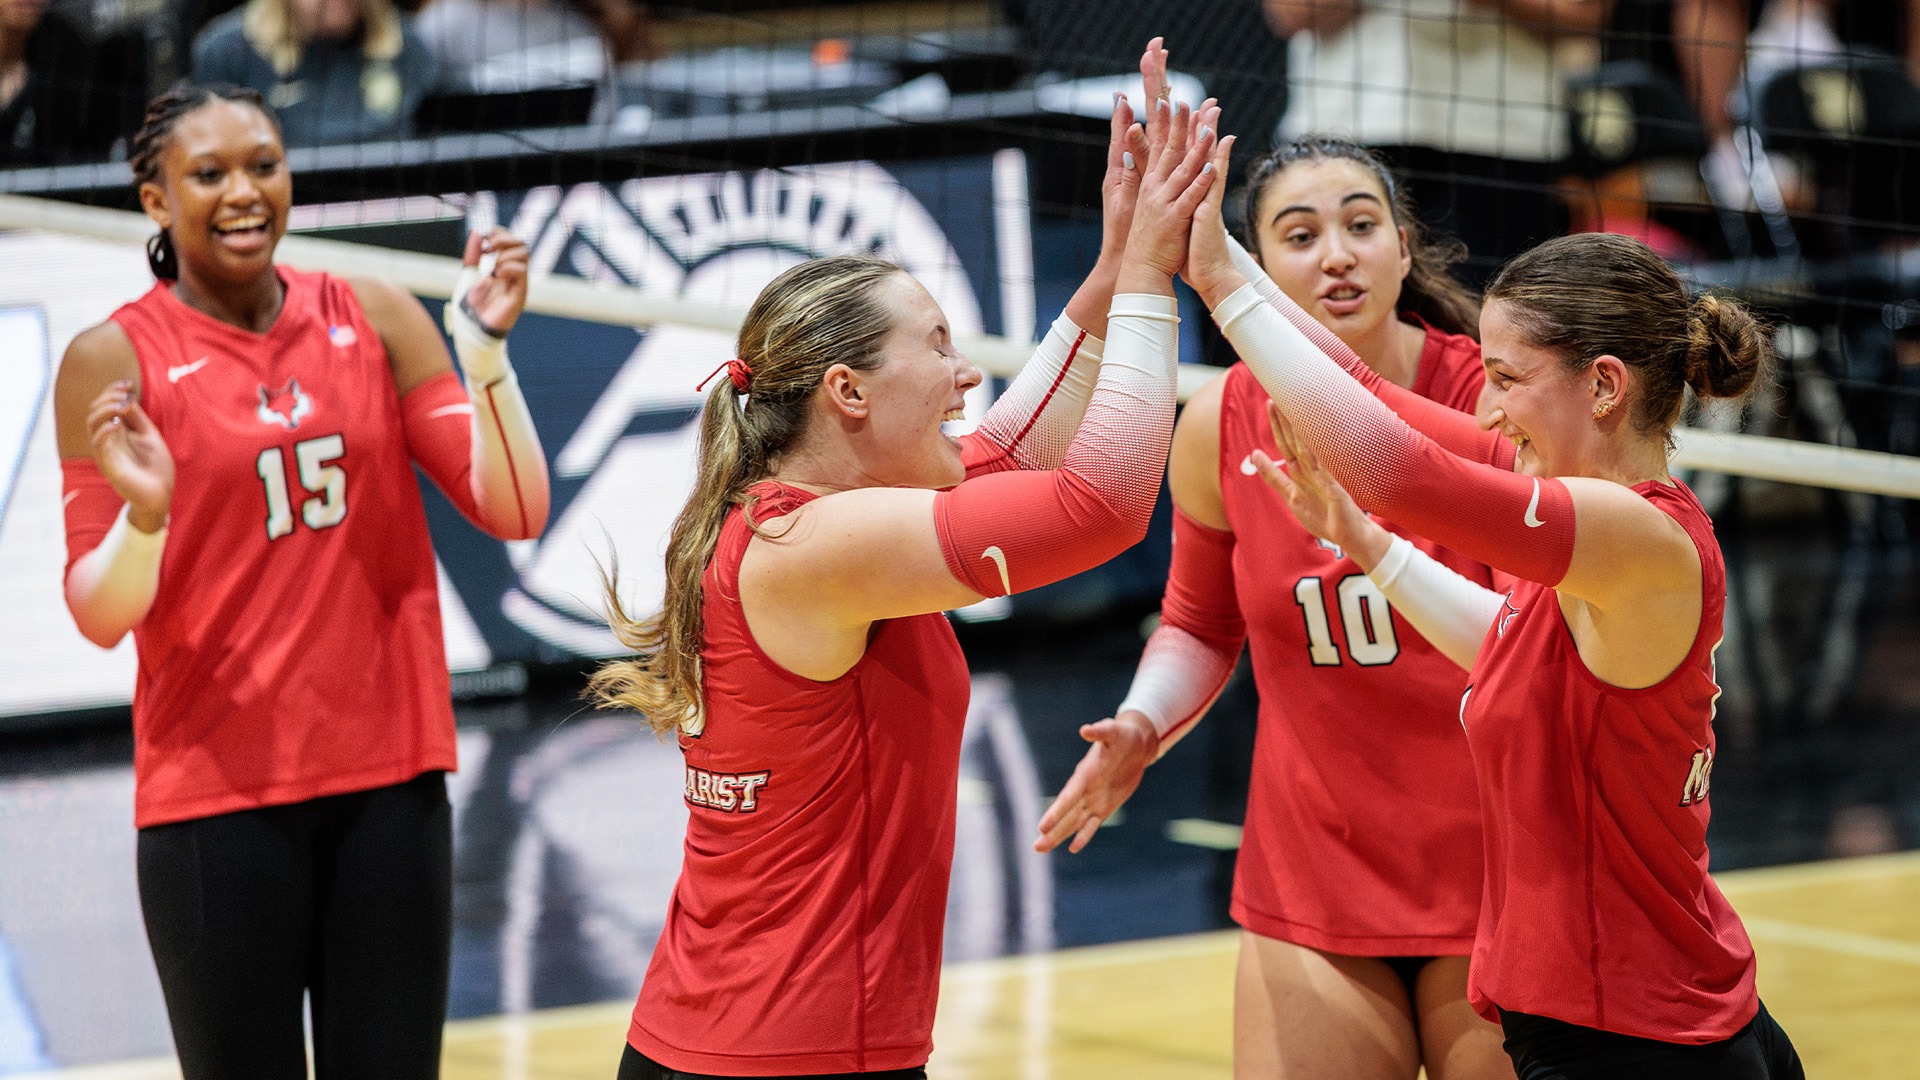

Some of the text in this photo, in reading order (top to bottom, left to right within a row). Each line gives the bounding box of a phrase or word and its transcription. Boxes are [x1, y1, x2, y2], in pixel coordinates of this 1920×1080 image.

[256, 432, 349, 542] 15
[1294, 573, 1400, 667] 10
[684, 765, 771, 813] ARIST
